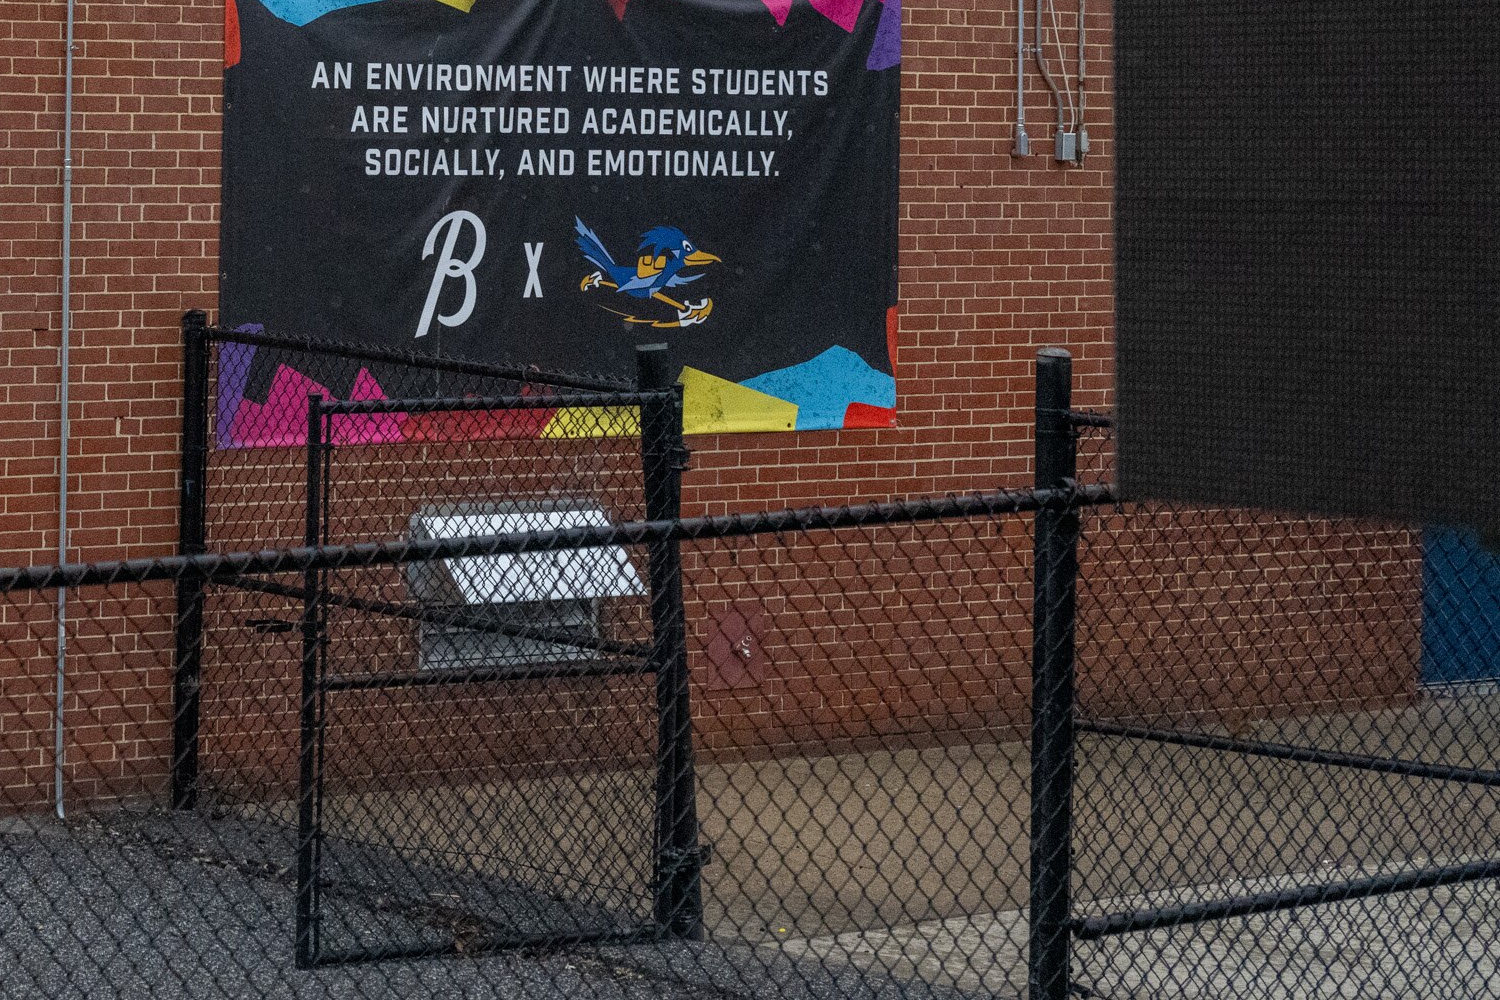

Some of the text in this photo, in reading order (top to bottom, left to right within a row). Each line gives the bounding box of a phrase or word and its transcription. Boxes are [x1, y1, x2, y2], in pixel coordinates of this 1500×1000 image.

[312, 62, 827, 95] AN ENVIRONMENT WHERE STUDENTS
[351, 106, 792, 139] ARE NURTURED ACADEMICALLY,
[366, 149, 778, 179] SOCIALLY, AND EMOTIONALLY.
[415, 210, 486, 337] B
